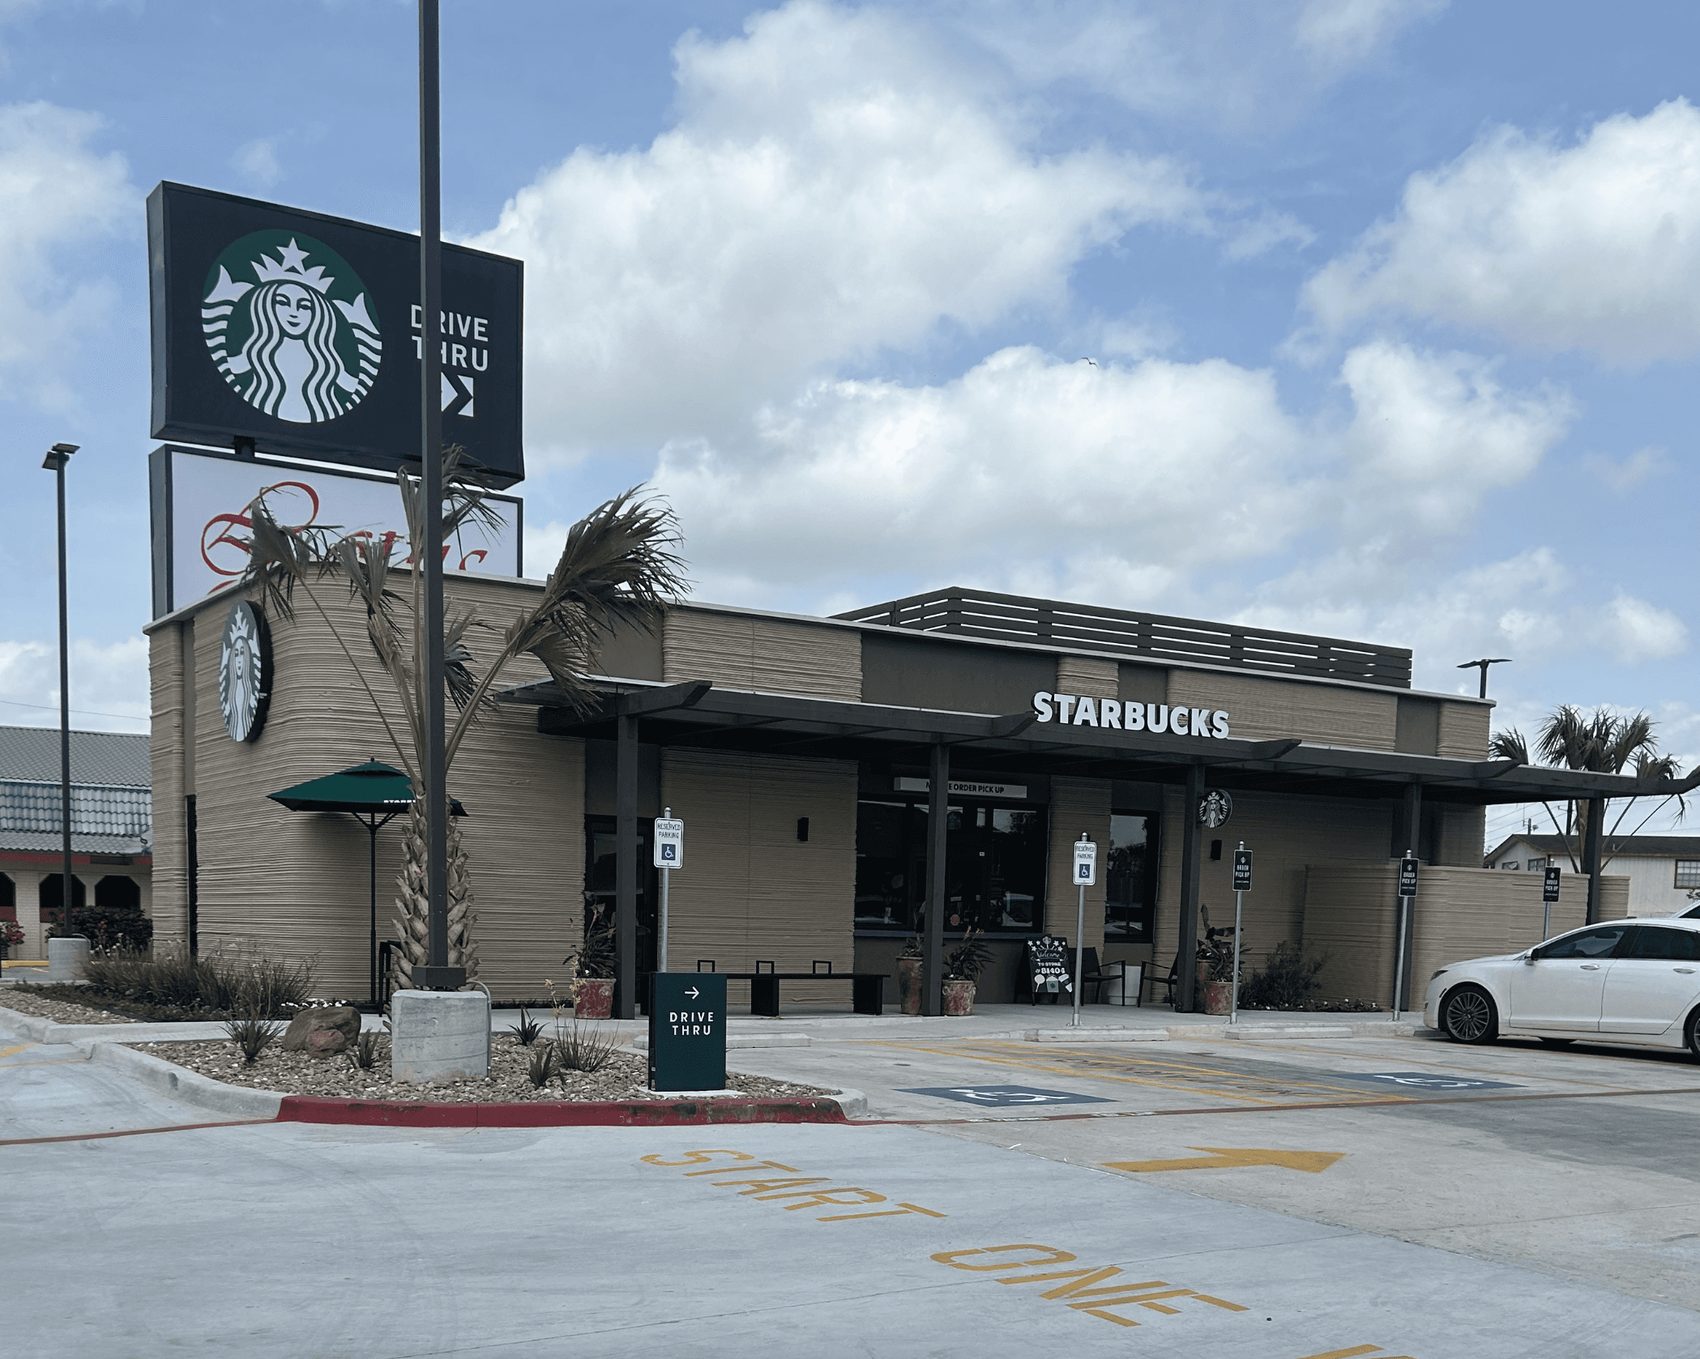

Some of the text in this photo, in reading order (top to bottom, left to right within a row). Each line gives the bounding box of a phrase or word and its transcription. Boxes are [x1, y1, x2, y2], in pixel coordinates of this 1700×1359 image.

[1033, 691, 1230, 739] STARBUCKS
[953, 783, 977, 792] ORDER
[978, 784, 994, 793] PICK
[995, 786, 1005, 794] UP
[658, 831, 679, 839] PARKING
[669, 1012, 714, 1022] DRIVE
[672, 1025, 711, 1036] THRU
[640, 1148, 948, 1222] START
[930, 1244, 1250, 1327] ONE
